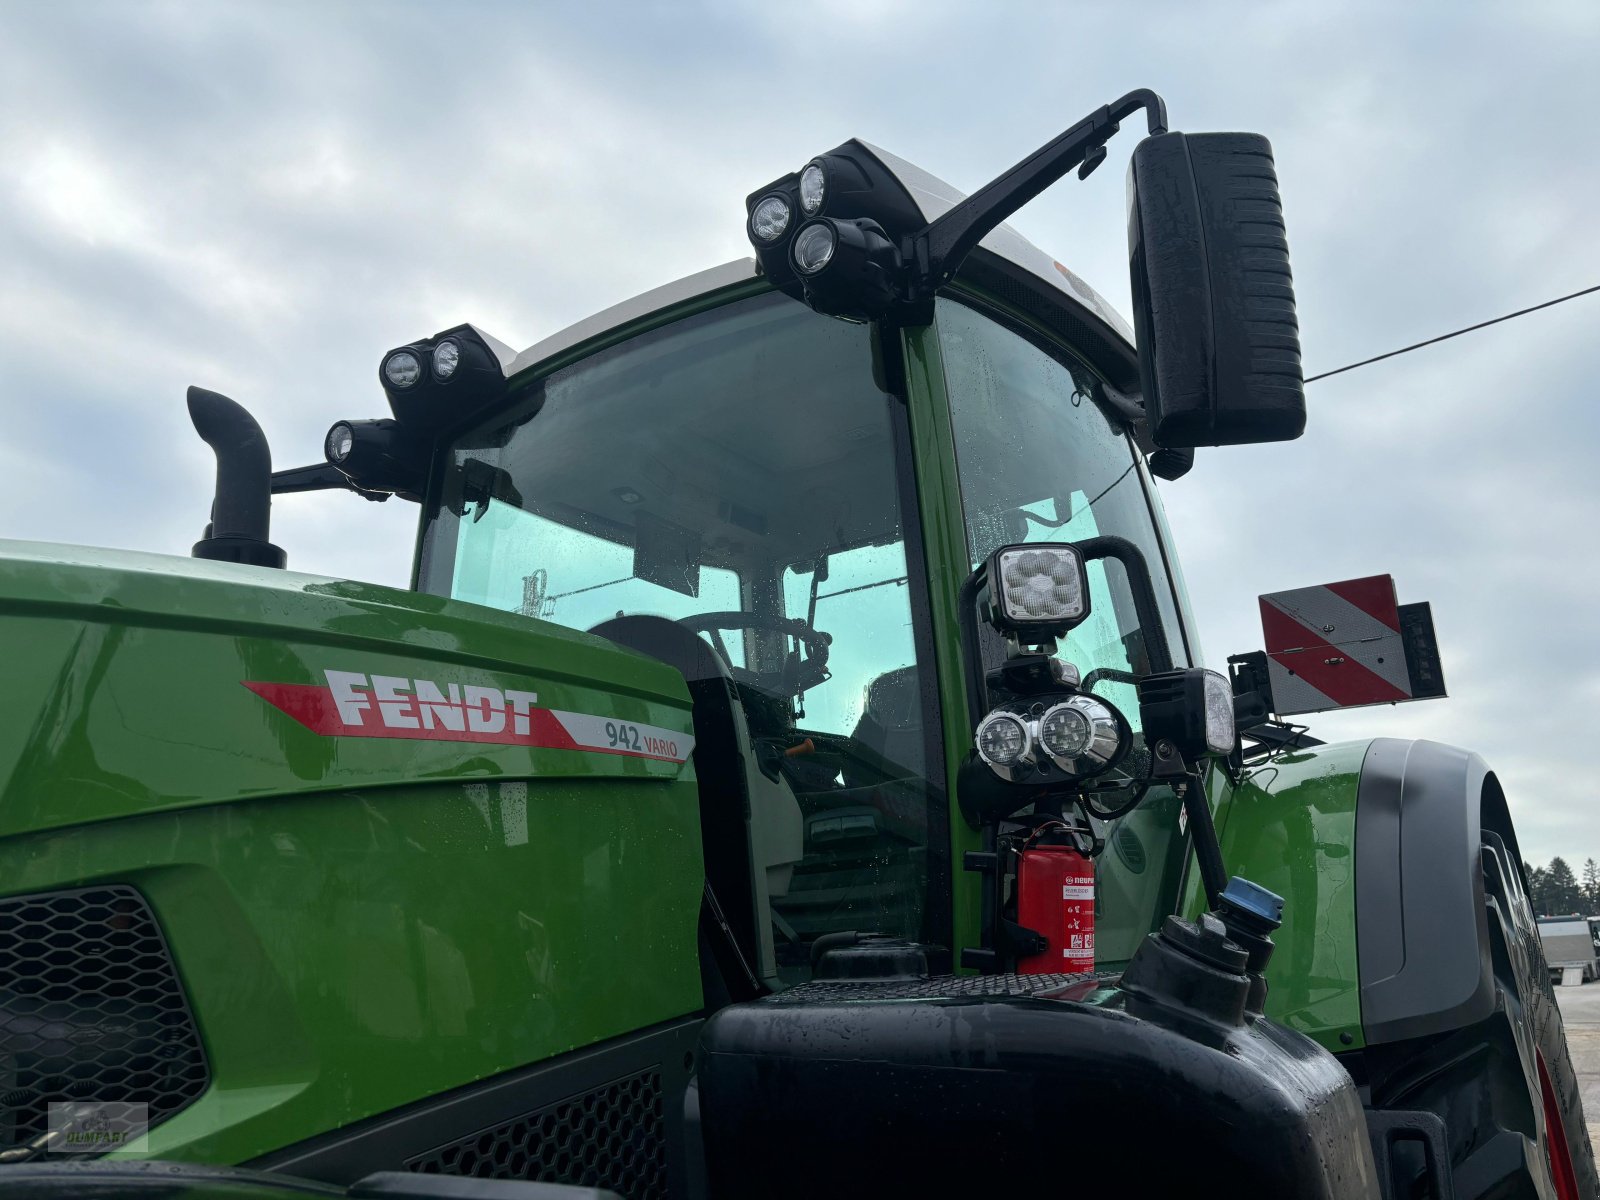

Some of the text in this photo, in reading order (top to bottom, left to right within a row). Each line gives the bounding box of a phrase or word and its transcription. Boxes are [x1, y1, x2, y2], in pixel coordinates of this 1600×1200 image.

[323, 669, 538, 736] FENDT
[605, 721, 678, 757] 942 VARIO
